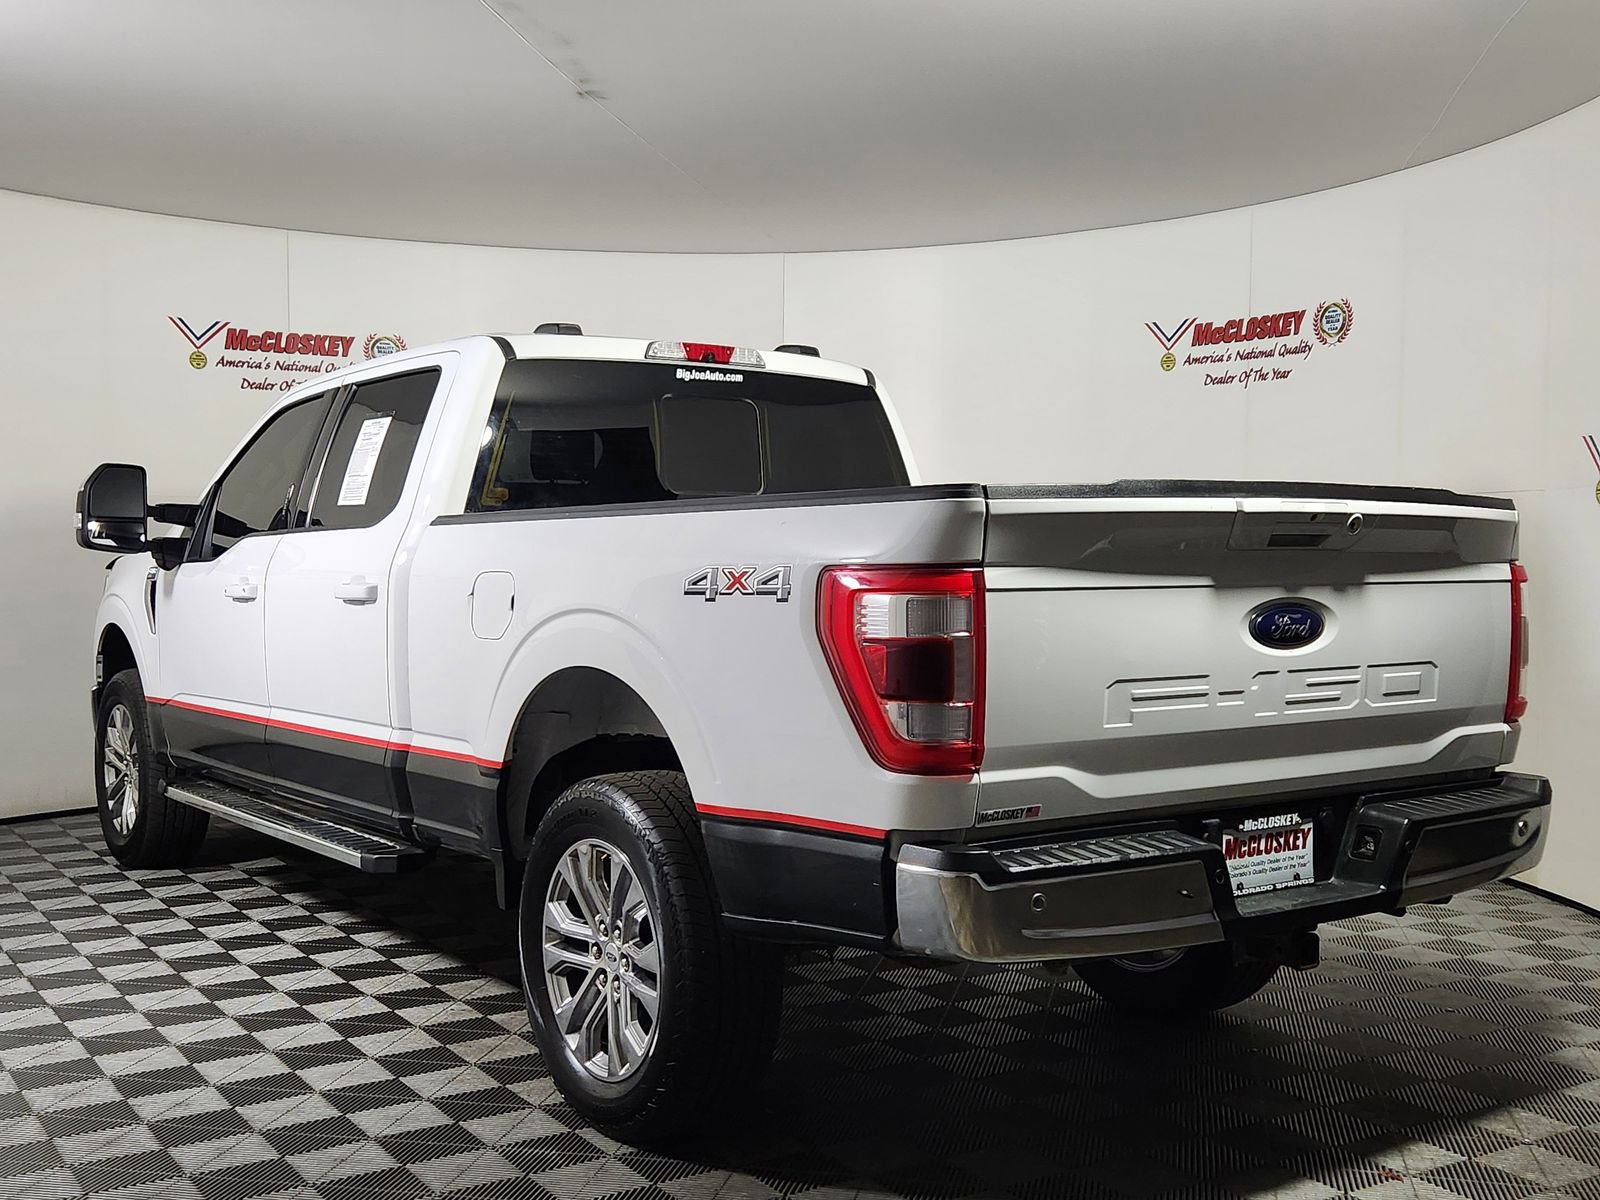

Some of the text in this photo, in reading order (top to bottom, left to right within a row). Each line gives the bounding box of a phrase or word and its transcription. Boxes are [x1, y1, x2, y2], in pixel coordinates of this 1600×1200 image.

[1191, 309, 1307, 347] McCLOSKEY
[224, 328, 356, 358] McCLOSKEY
[1182, 348, 1232, 366] America's
[1234, 342, 1276, 362] National
[1278, 339, 1314, 360] Quality
[215, 355, 271, 371] America's
[274, 359, 324, 373] National
[240, 377, 277, 391] Dealer
[279, 379, 296, 392] Of
[676, 368, 743, 382] BigJoeAuto.com
[1204, 367, 1293, 389] Dealer Of The Year
[1271, 612, 1312, 639] Ford
[1103, 661, 1439, 728] F-150
[979, 808, 1026, 824] McCLOSKEY
[1243, 813, 1298, 831] McCLOSKEY
[1224, 827, 1312, 861] McCLOSKEY
[1230, 870, 1251, 878] olorado's
[1233, 878, 1314, 896] OLORADO SPRINGS
